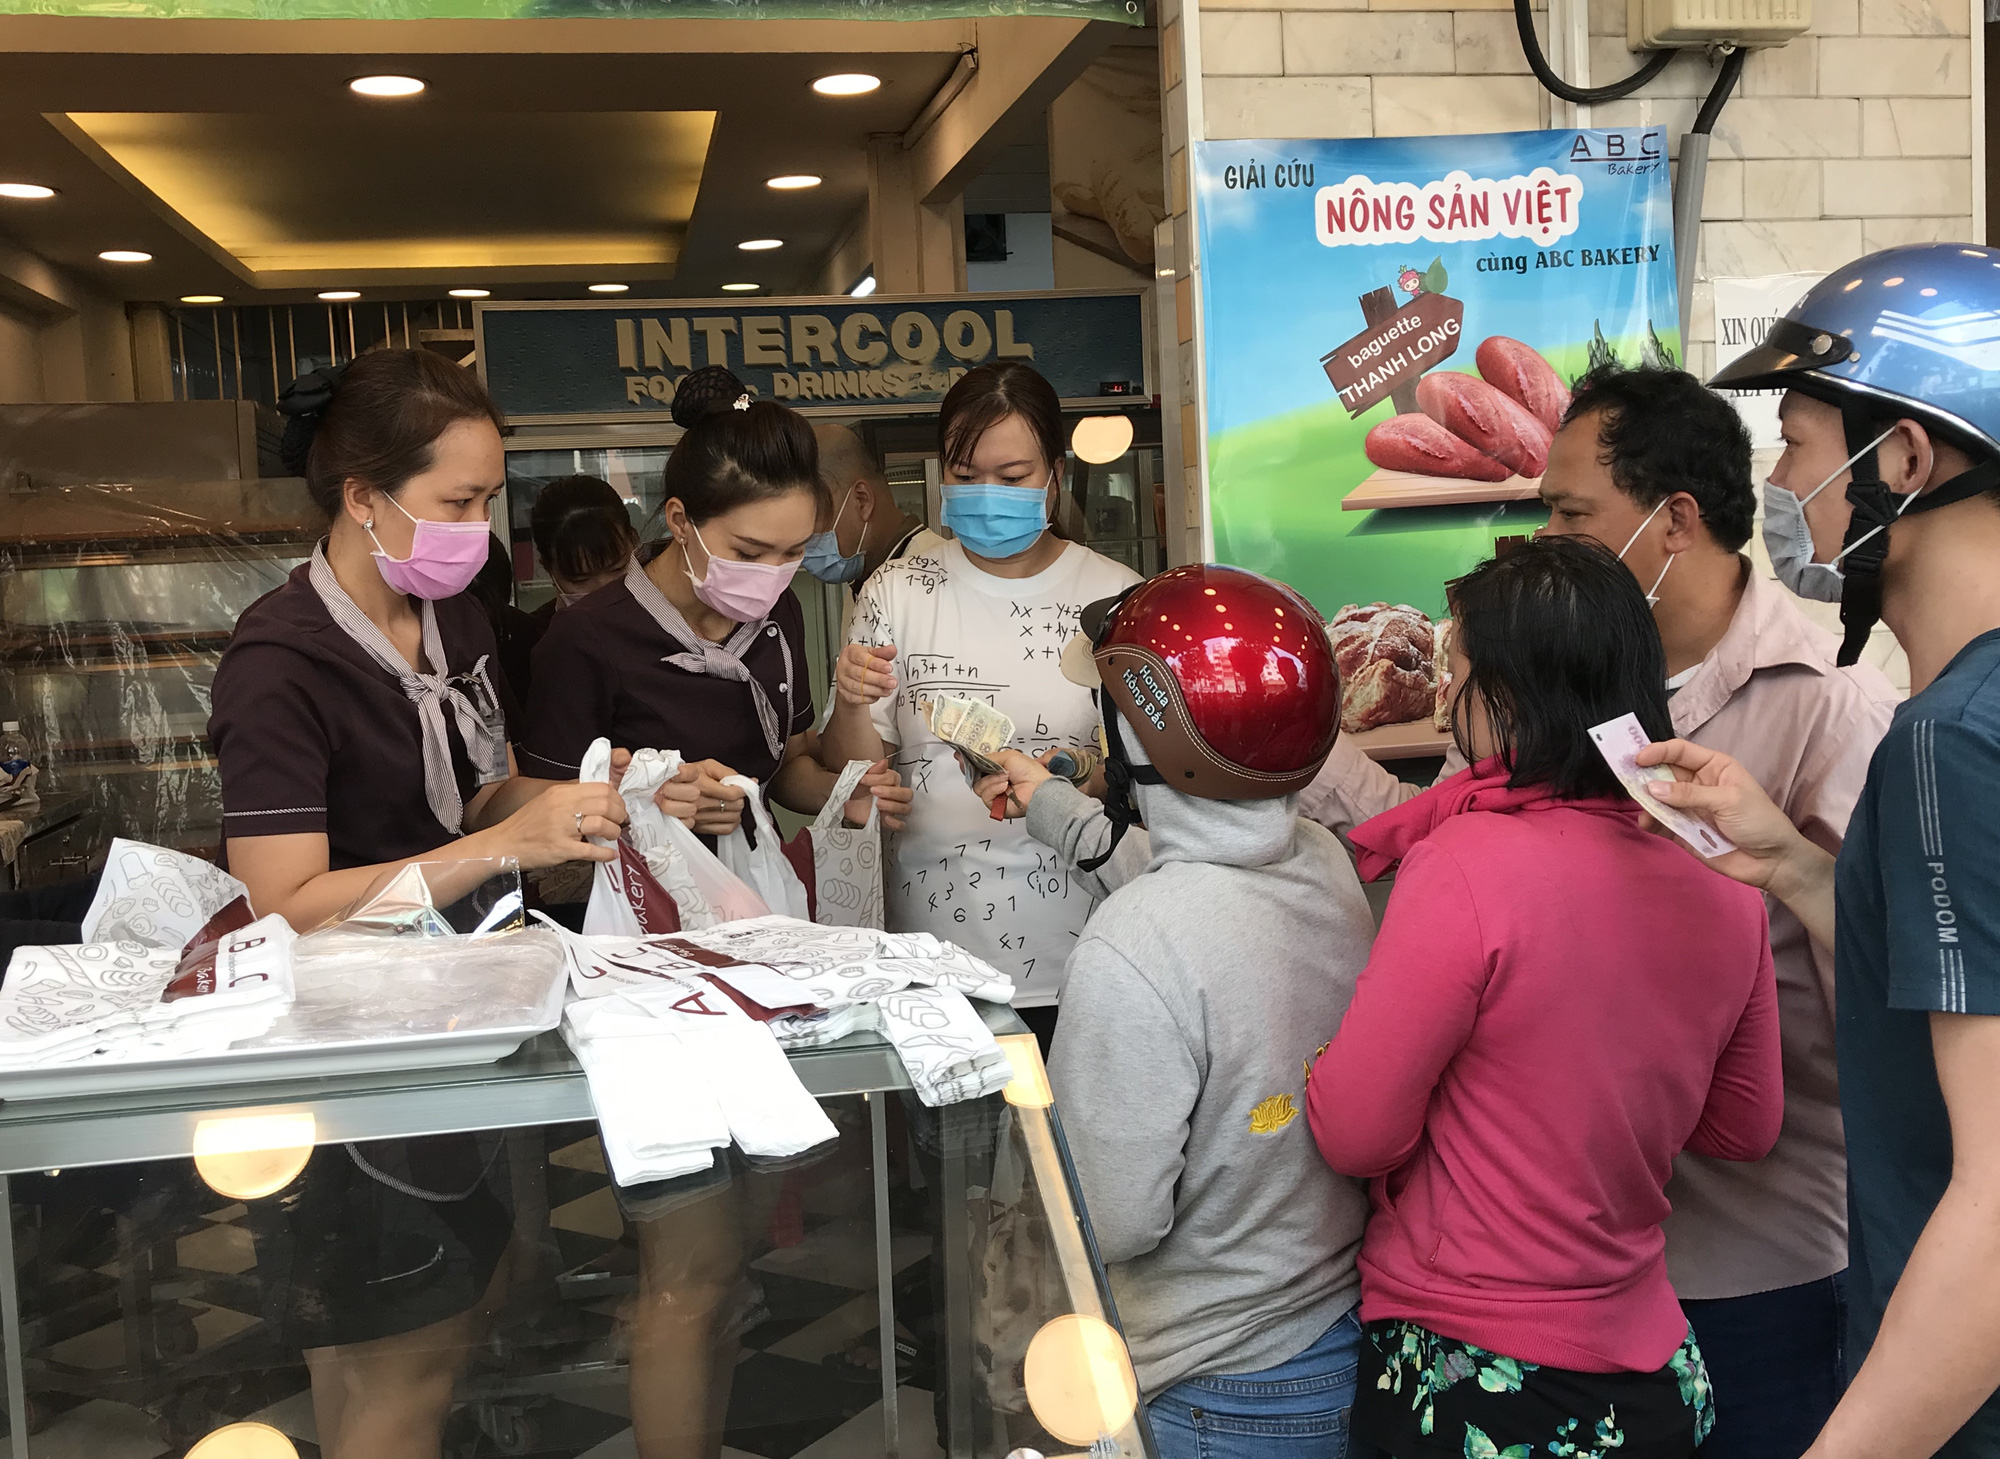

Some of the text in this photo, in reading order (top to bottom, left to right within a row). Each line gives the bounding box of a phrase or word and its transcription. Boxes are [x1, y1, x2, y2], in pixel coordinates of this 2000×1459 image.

[1224, 158, 1315, 190] GIẢI CỨU
[1607, 160, 1661, 177] Bakery
[1326, 180, 1572, 234] NÔNG SẢN VIỆT
[1476, 244, 1661, 274] cùng ABC BAKERY
[615, 311, 1034, 372] INTERCOOL
[1347, 313, 1423, 369] baguette
[1721, 317, 1747, 345] XIN
[772, 370, 905, 400] DRINKS
[1341, 317, 1462, 404] THANH LONG
[1122, 668, 1165, 731] Hồng Đắc
[1139, 664, 1169, 707] Honda
[626, 864, 650, 935] akery
[1928, 862, 1959, 943] PODOM
